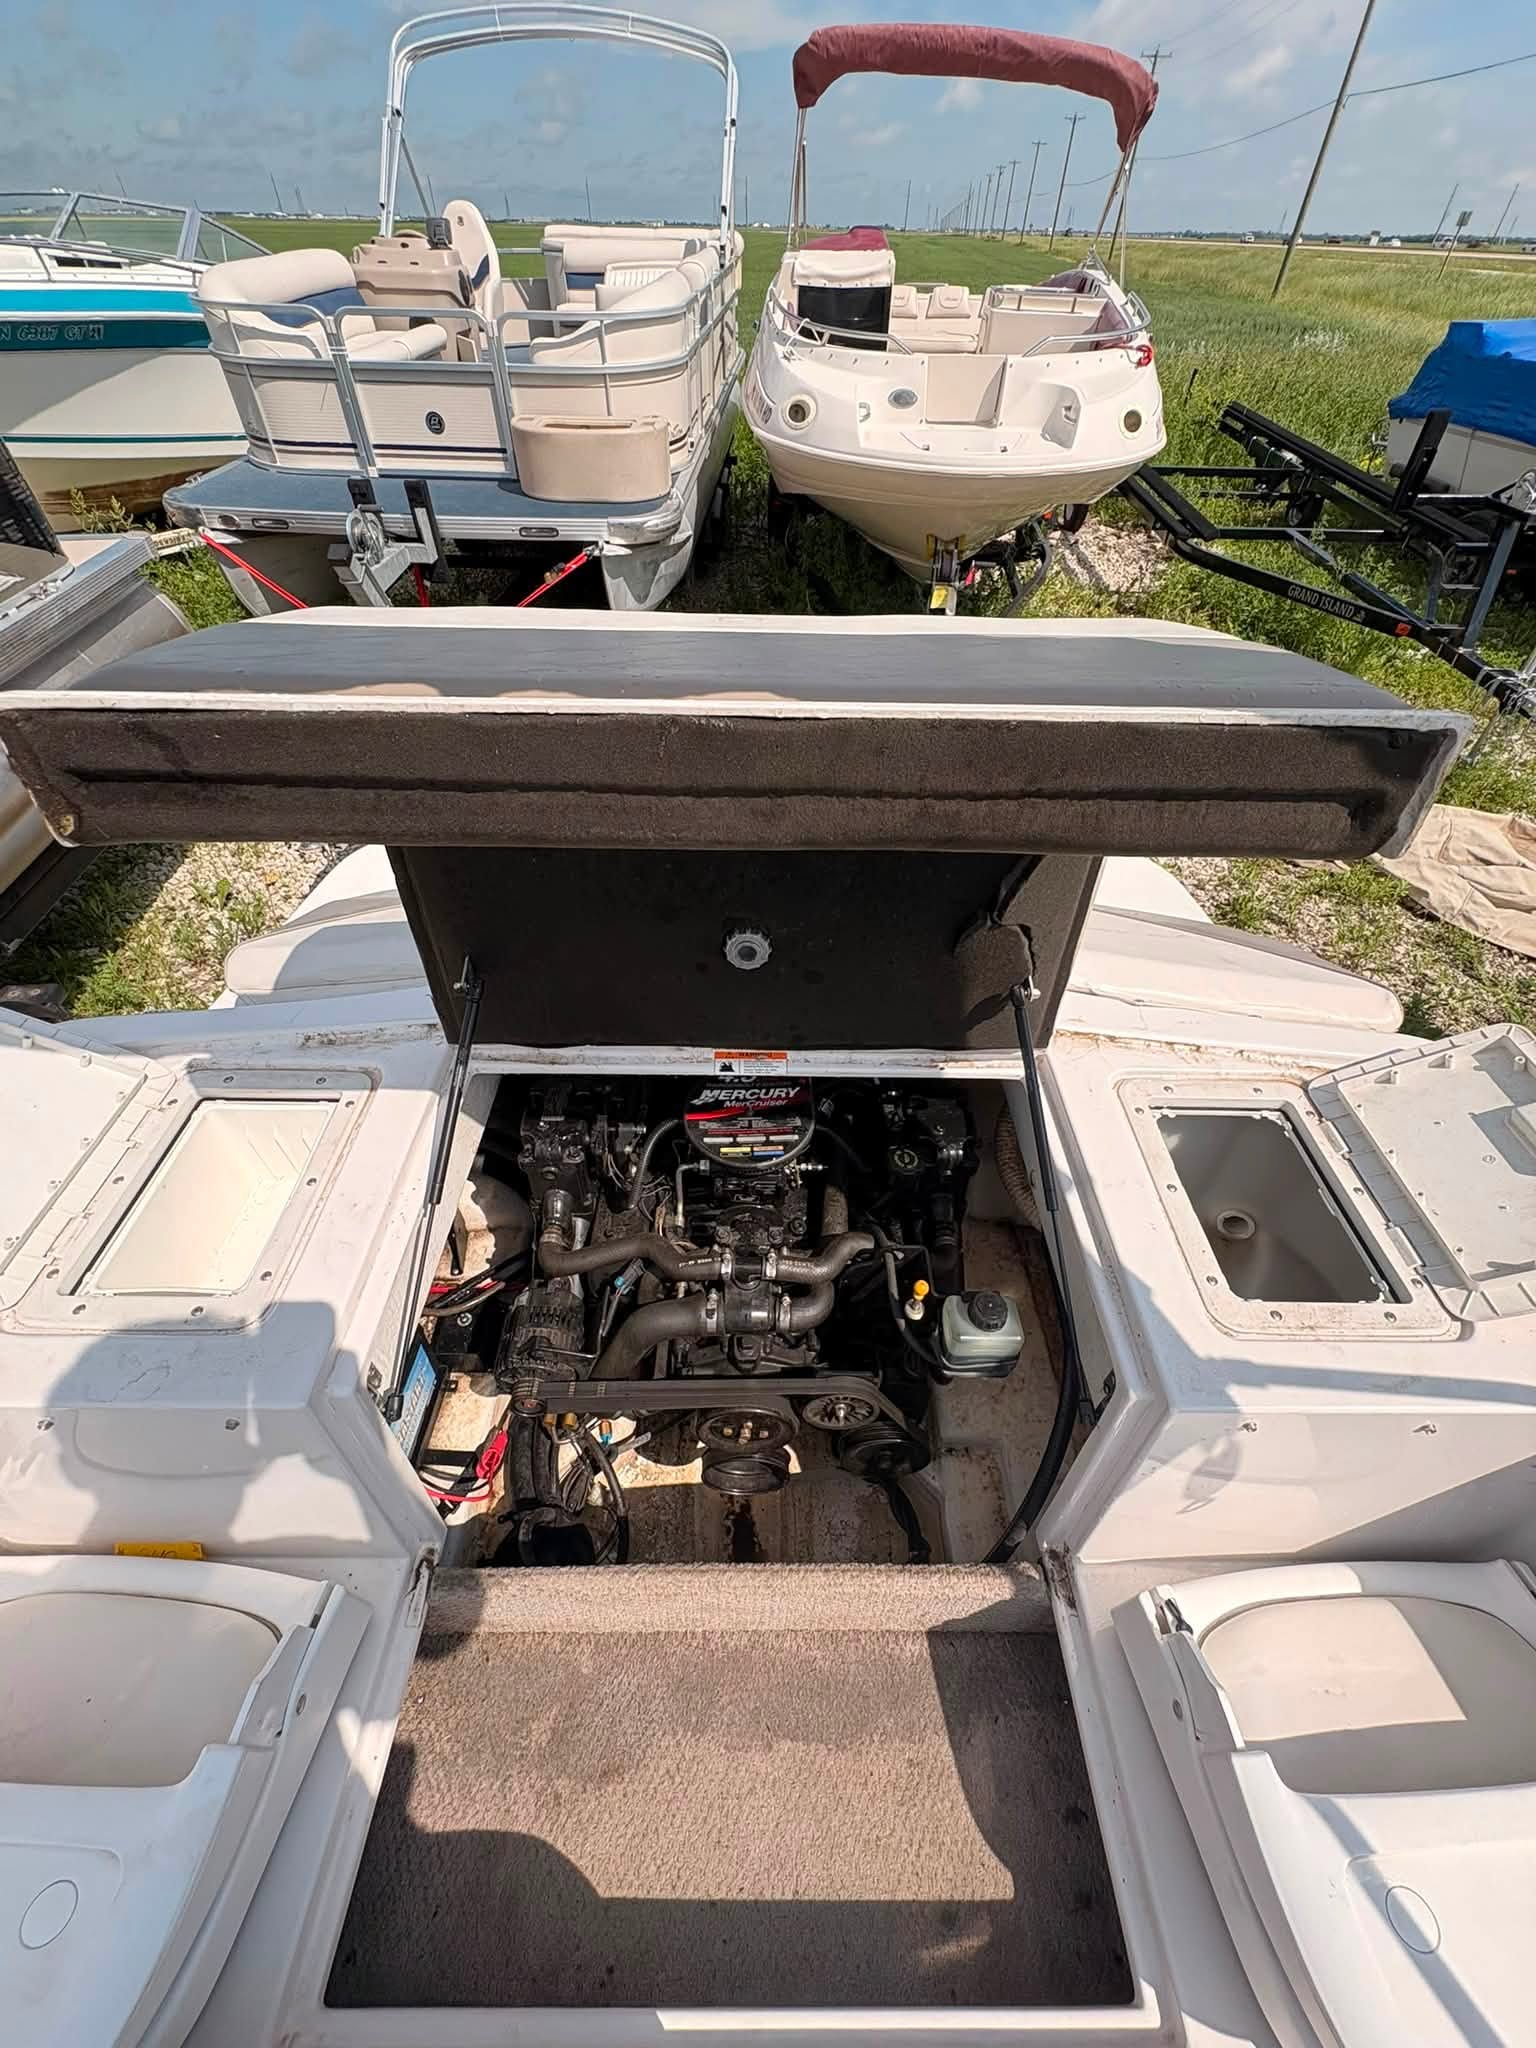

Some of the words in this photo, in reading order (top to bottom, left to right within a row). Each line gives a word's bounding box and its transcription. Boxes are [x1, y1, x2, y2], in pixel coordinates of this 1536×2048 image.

[1287, 585, 1319, 605] GRAND
[1320, 596, 1355, 617] ISLAND
[691, 1087, 800, 1105] MERCURY
[723, 1099, 789, 1108] MerCruiser
